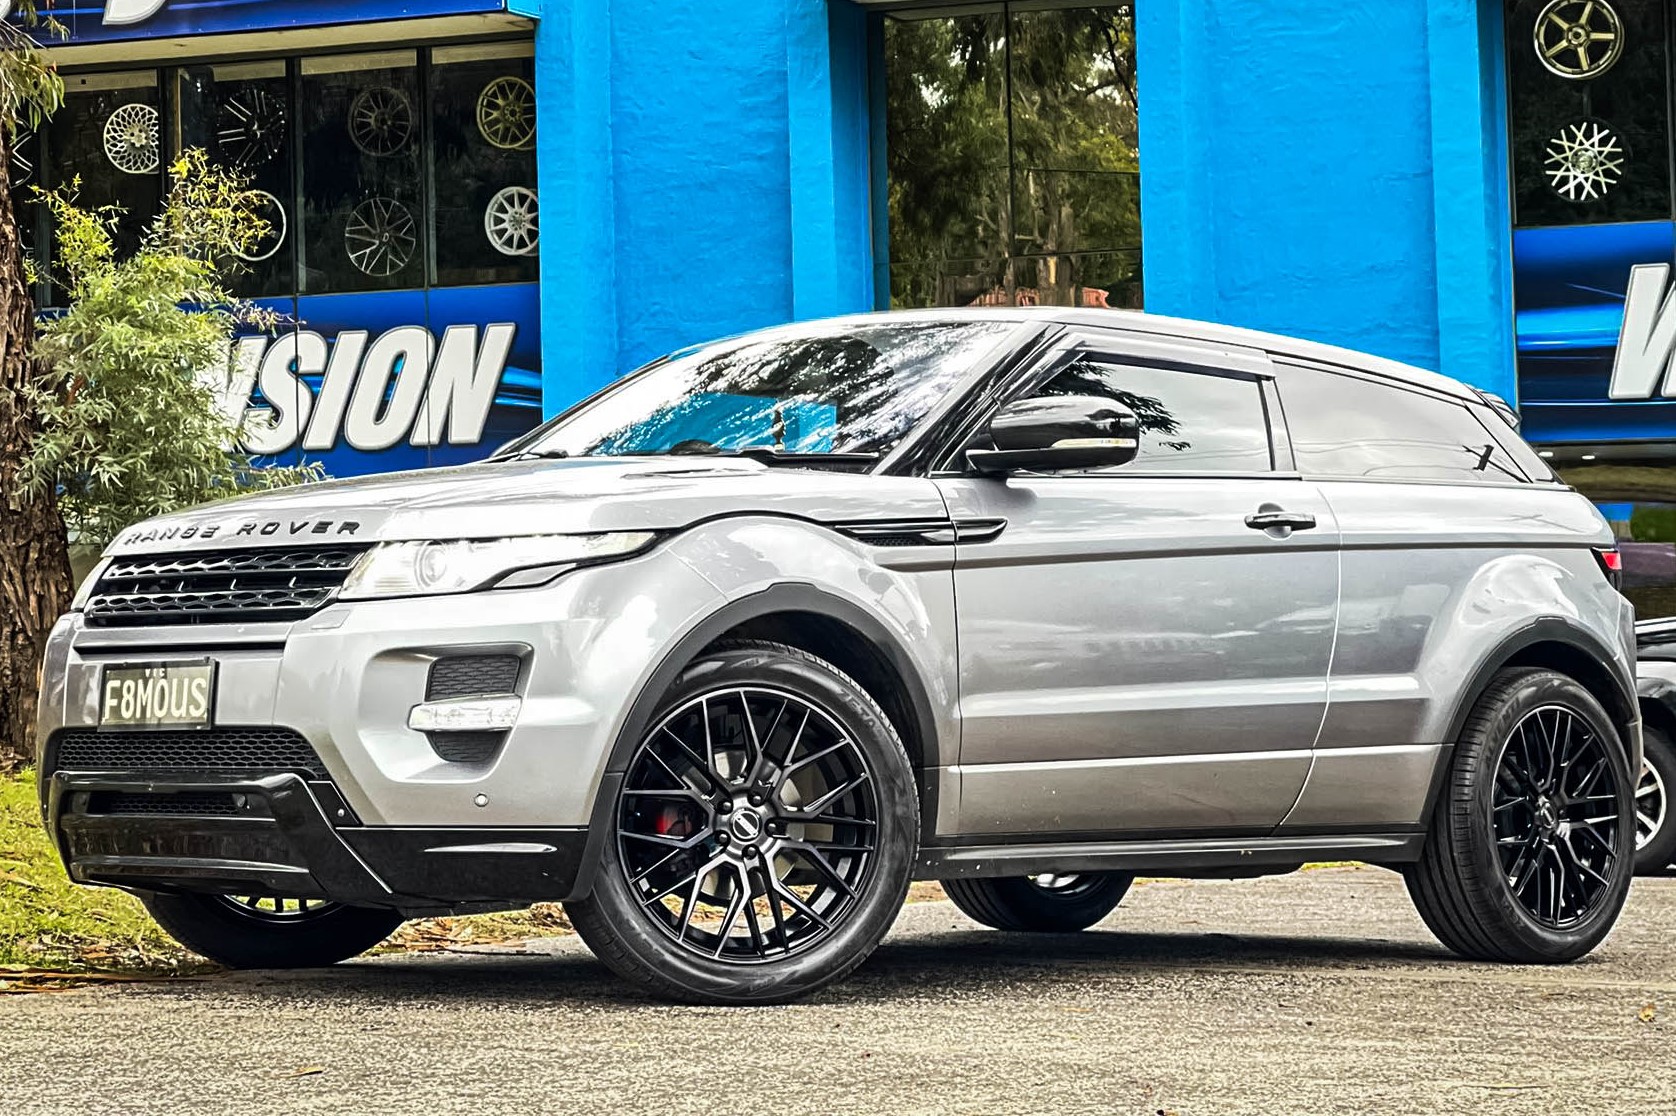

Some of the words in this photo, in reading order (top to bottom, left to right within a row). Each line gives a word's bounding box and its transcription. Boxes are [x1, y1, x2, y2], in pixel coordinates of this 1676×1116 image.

[124, 525, 220, 546] RANGE
[236, 520, 361, 537] ROVER
[144, 668, 166, 678] VIC
[103, 677, 207, 720] F8MOUS
